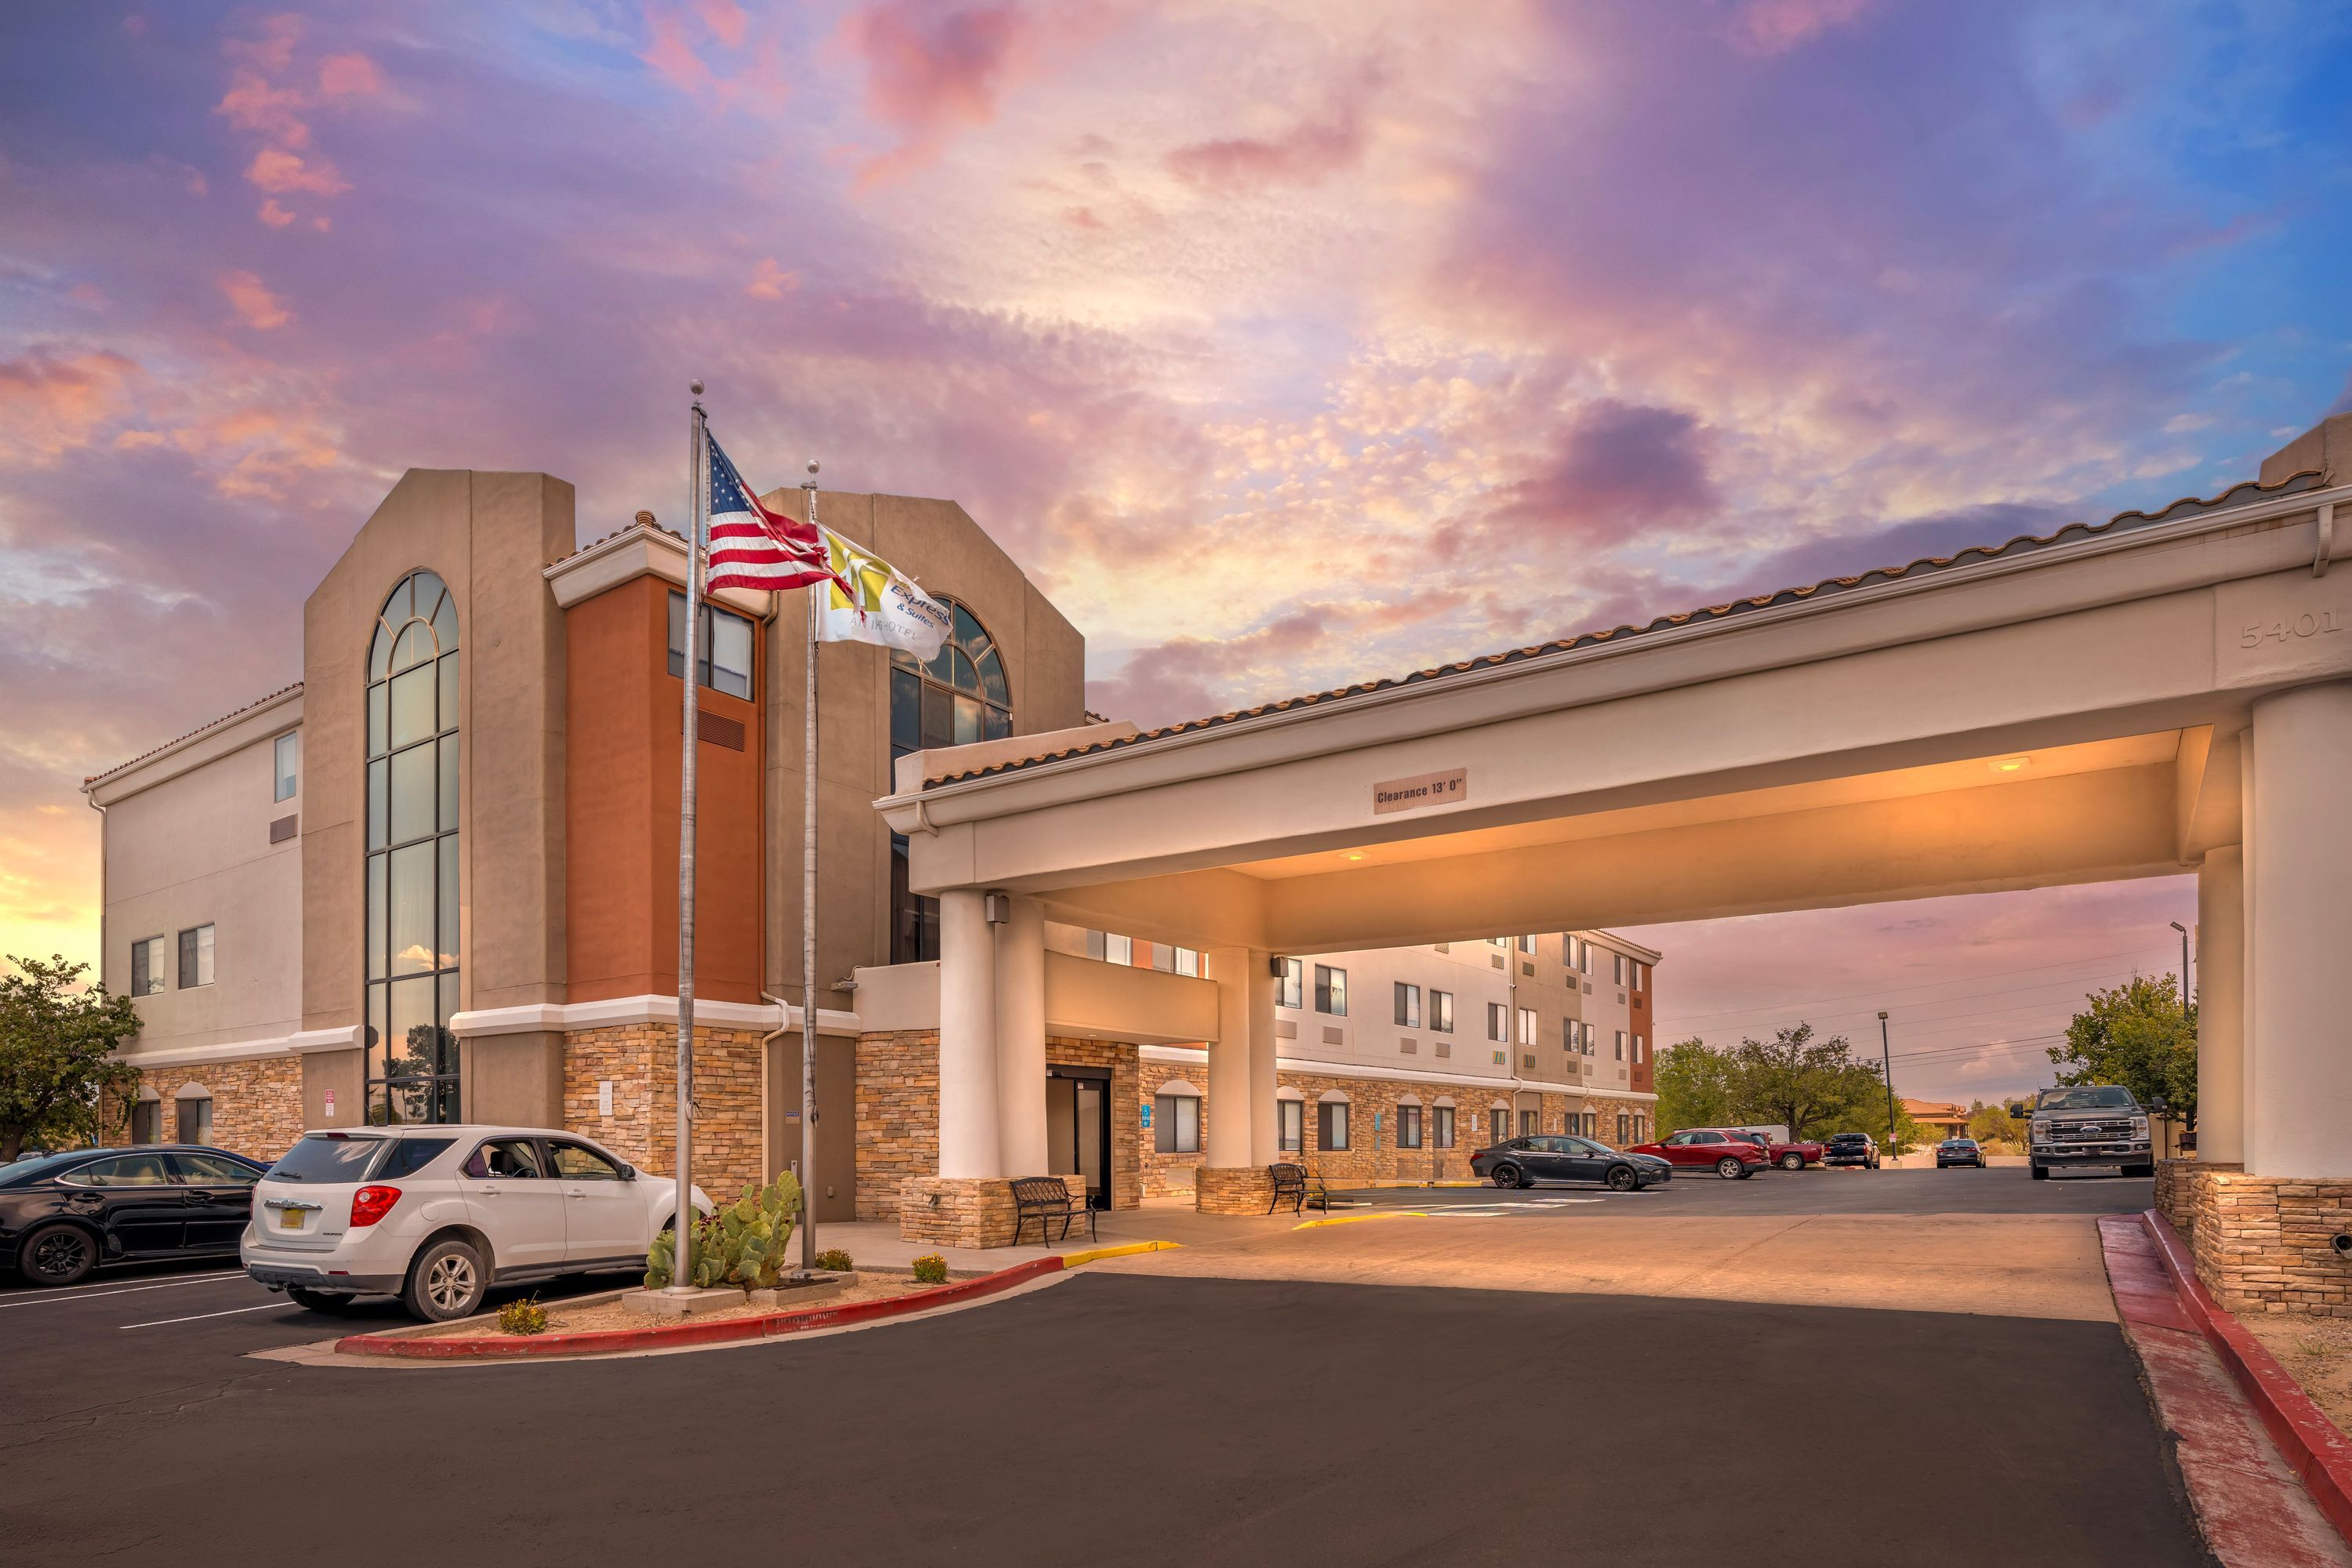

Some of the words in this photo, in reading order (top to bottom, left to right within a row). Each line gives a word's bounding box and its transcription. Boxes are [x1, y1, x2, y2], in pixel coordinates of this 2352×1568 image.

[891, 585, 949, 626] Express
[896, 603, 905, 612] &
[906, 608, 935, 628] Suites
[883, 621, 916, 641] HOTEL
[2241, 608, 2343, 648] 5401
[1377, 787, 1428, 804] Clearance
[1432, 781, 1446, 794] 13'
